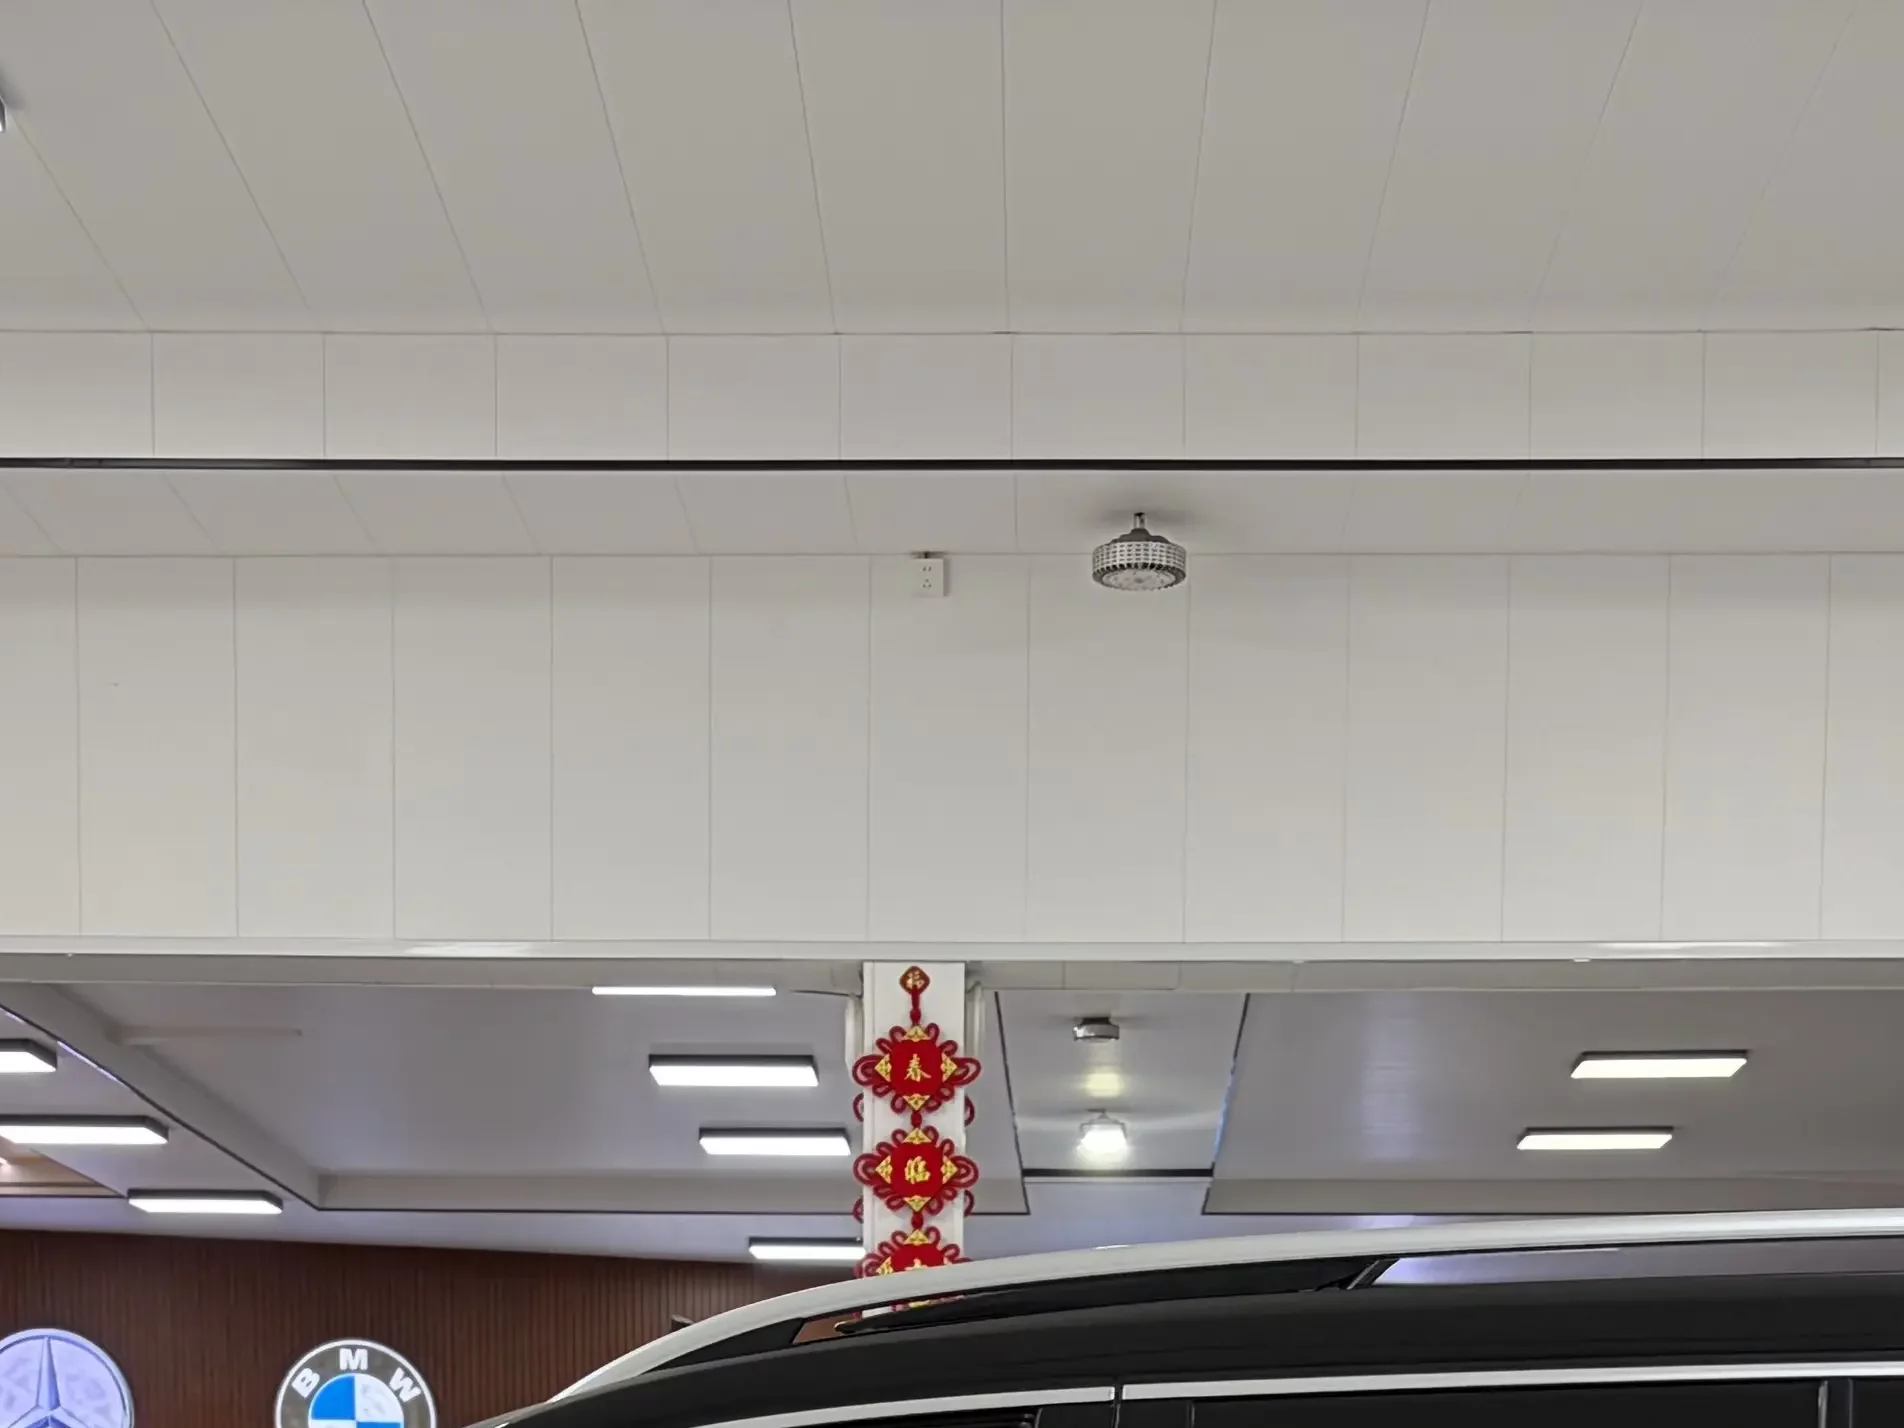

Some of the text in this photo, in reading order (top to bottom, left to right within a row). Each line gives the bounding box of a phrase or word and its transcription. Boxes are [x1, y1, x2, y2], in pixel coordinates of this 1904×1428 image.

[903, 1053, 932, 1082] 春
[904, 1155, 931, 1185] 临
[291, 1347, 422, 1403] BMW
